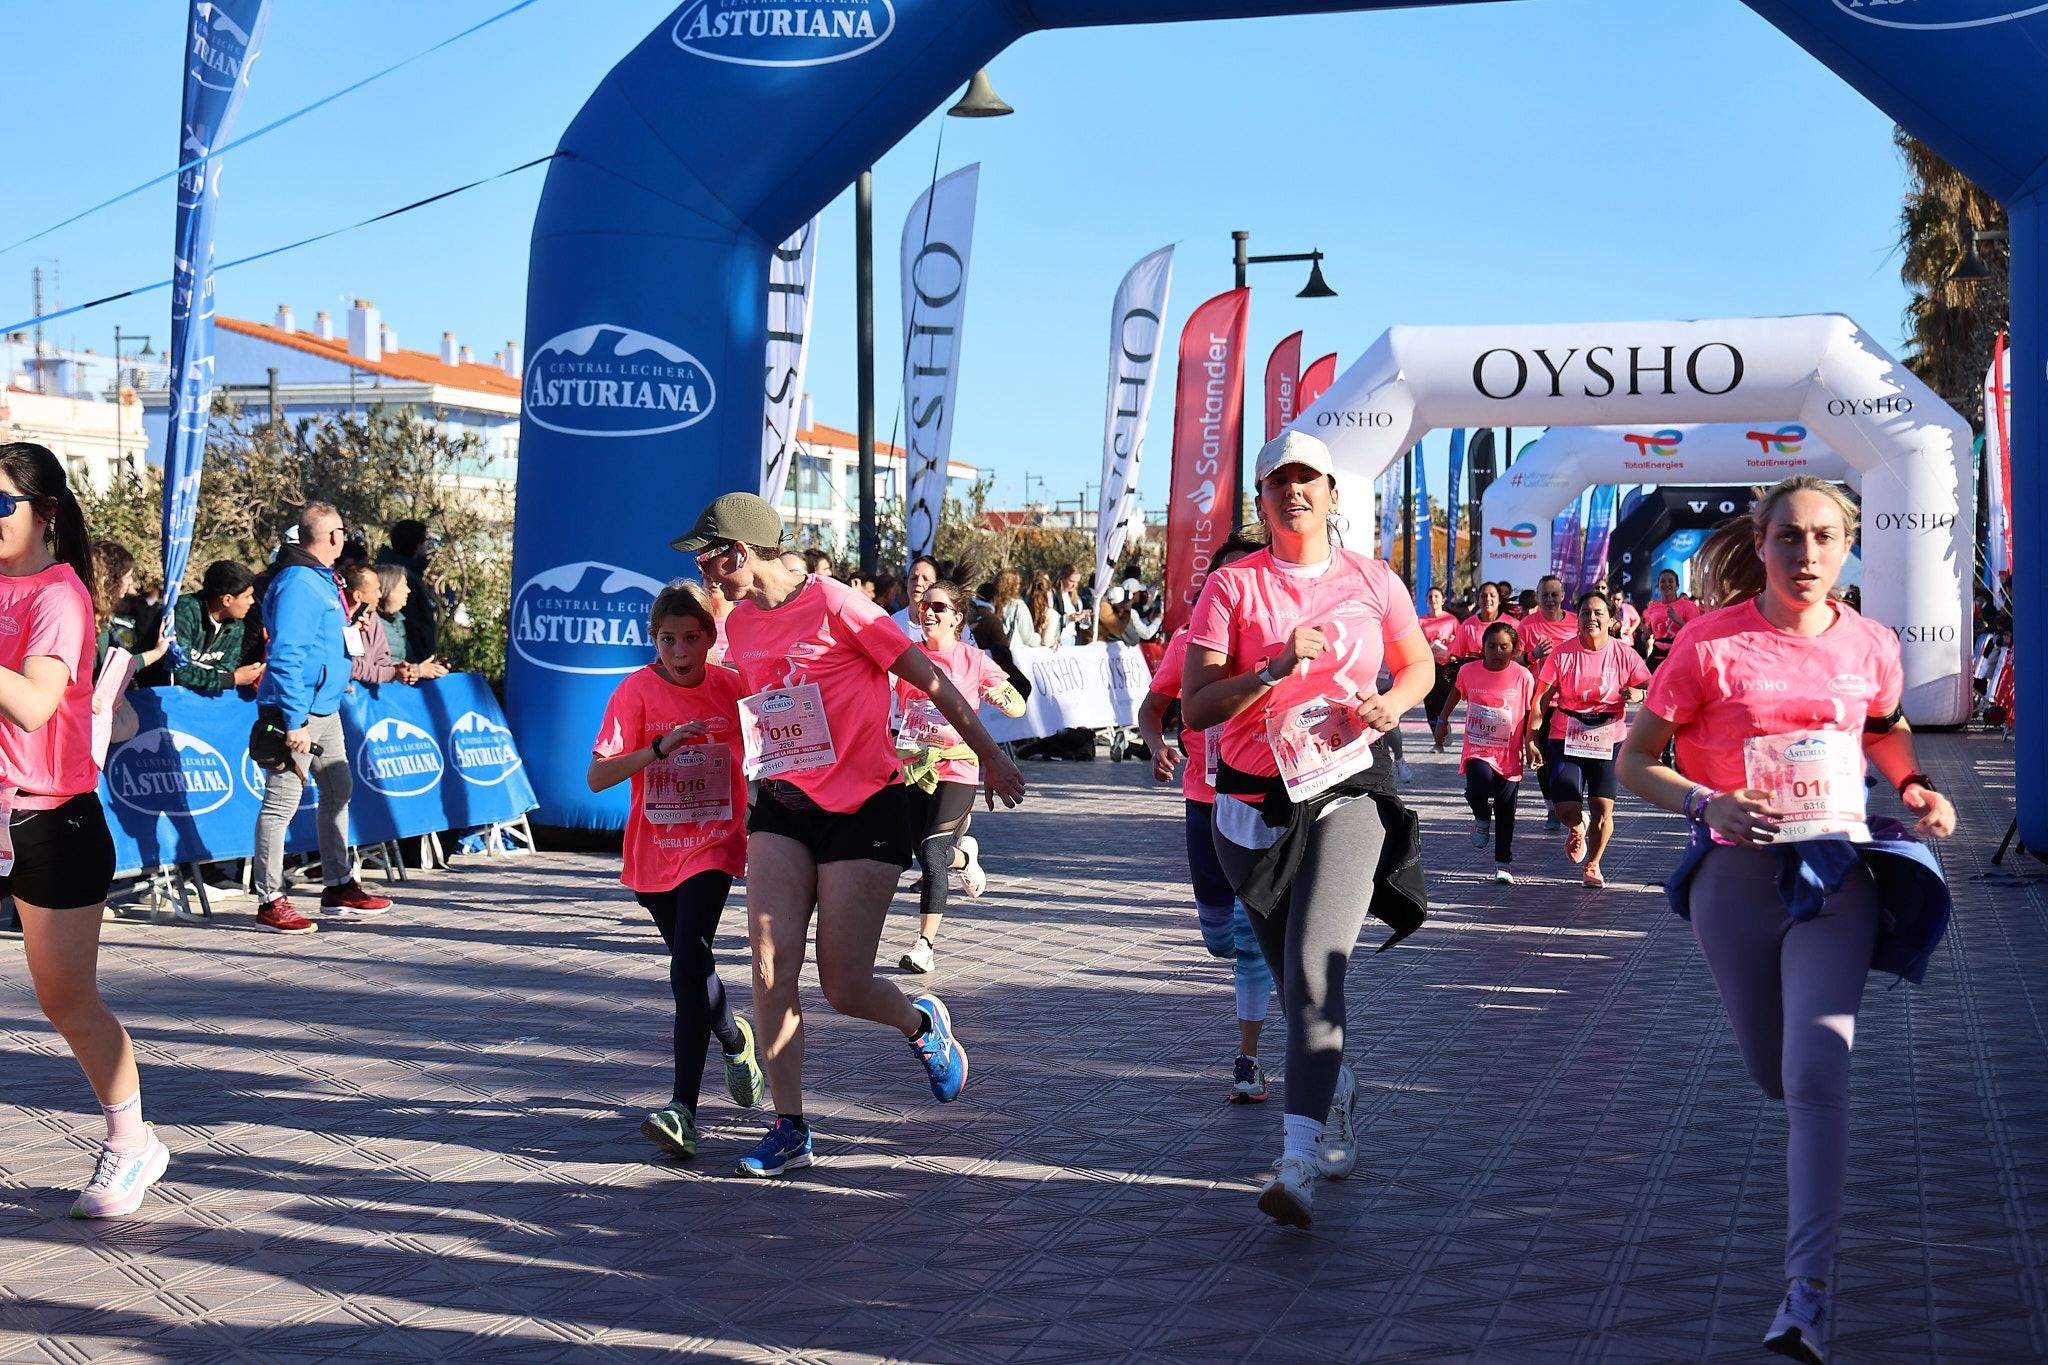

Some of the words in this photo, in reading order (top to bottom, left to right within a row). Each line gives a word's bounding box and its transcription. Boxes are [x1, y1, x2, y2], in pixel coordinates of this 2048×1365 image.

[683, 5, 876, 40] ASTURIANA
[550, 362, 612, 374] CENTRAL
[621, 363, 694, 379] LECHERA
[1473, 343, 1744, 399] OYSHO
[529, 366, 700, 413] ASTURIANA
[1196, 332, 1228, 475] Santander
[1828, 397, 1912, 416] OYSHO
[1316, 411, 1393, 427] OYSHO
[1624, 461, 1684, 470] TotalEnergies
[1746, 458, 1807, 467] TotalEnergies
[1876, 513, 1955, 530] OYSHO
[537, 599, 600, 611] CENTRAL
[607, 601, 650, 613] LECH
[517, 601, 656, 647] ASTURIA
[1892, 625, 1954, 642] YSHO
[770, 723, 802, 740] 016
[920, 723, 939, 734] 016
[1480, 723, 1497, 732] 016
[1582, 734, 1599, 742] 016
[367, 752, 441, 780] ASTURIANA
[122, 762, 229, 797] ASTURIANA
[676, 779, 705, 793] 016
[1782, 825, 1807, 836] SHO
